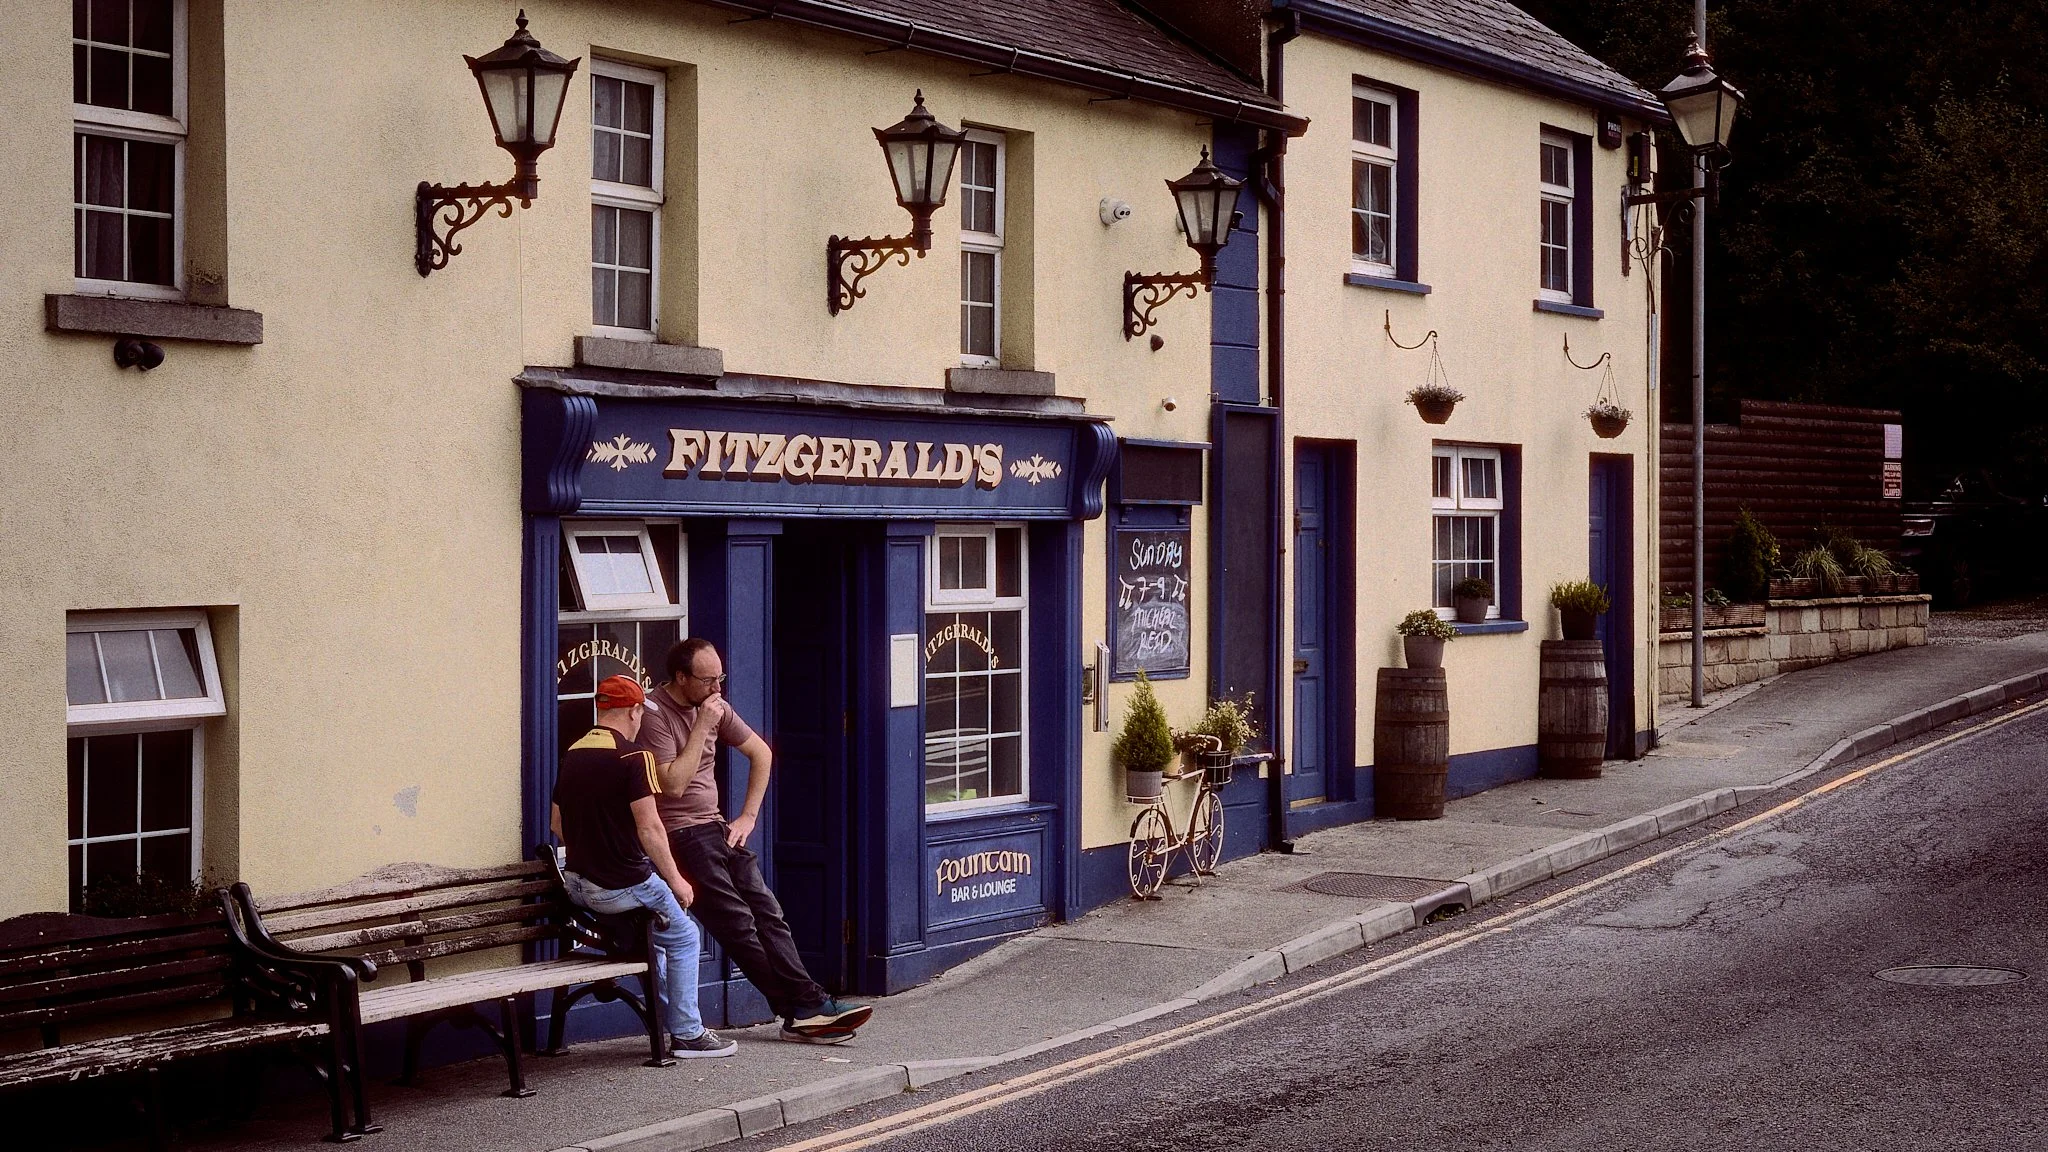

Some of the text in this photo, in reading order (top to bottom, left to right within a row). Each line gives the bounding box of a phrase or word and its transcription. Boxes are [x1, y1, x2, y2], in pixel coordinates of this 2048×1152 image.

[664, 428, 1004, 489] FITZGERALD'S
[556, 639, 655, 694] TZGERALD'S
[924, 623, 999, 669] ITZGERALD'S
[951, 878, 1017, 903] BAR & LOUNGE
